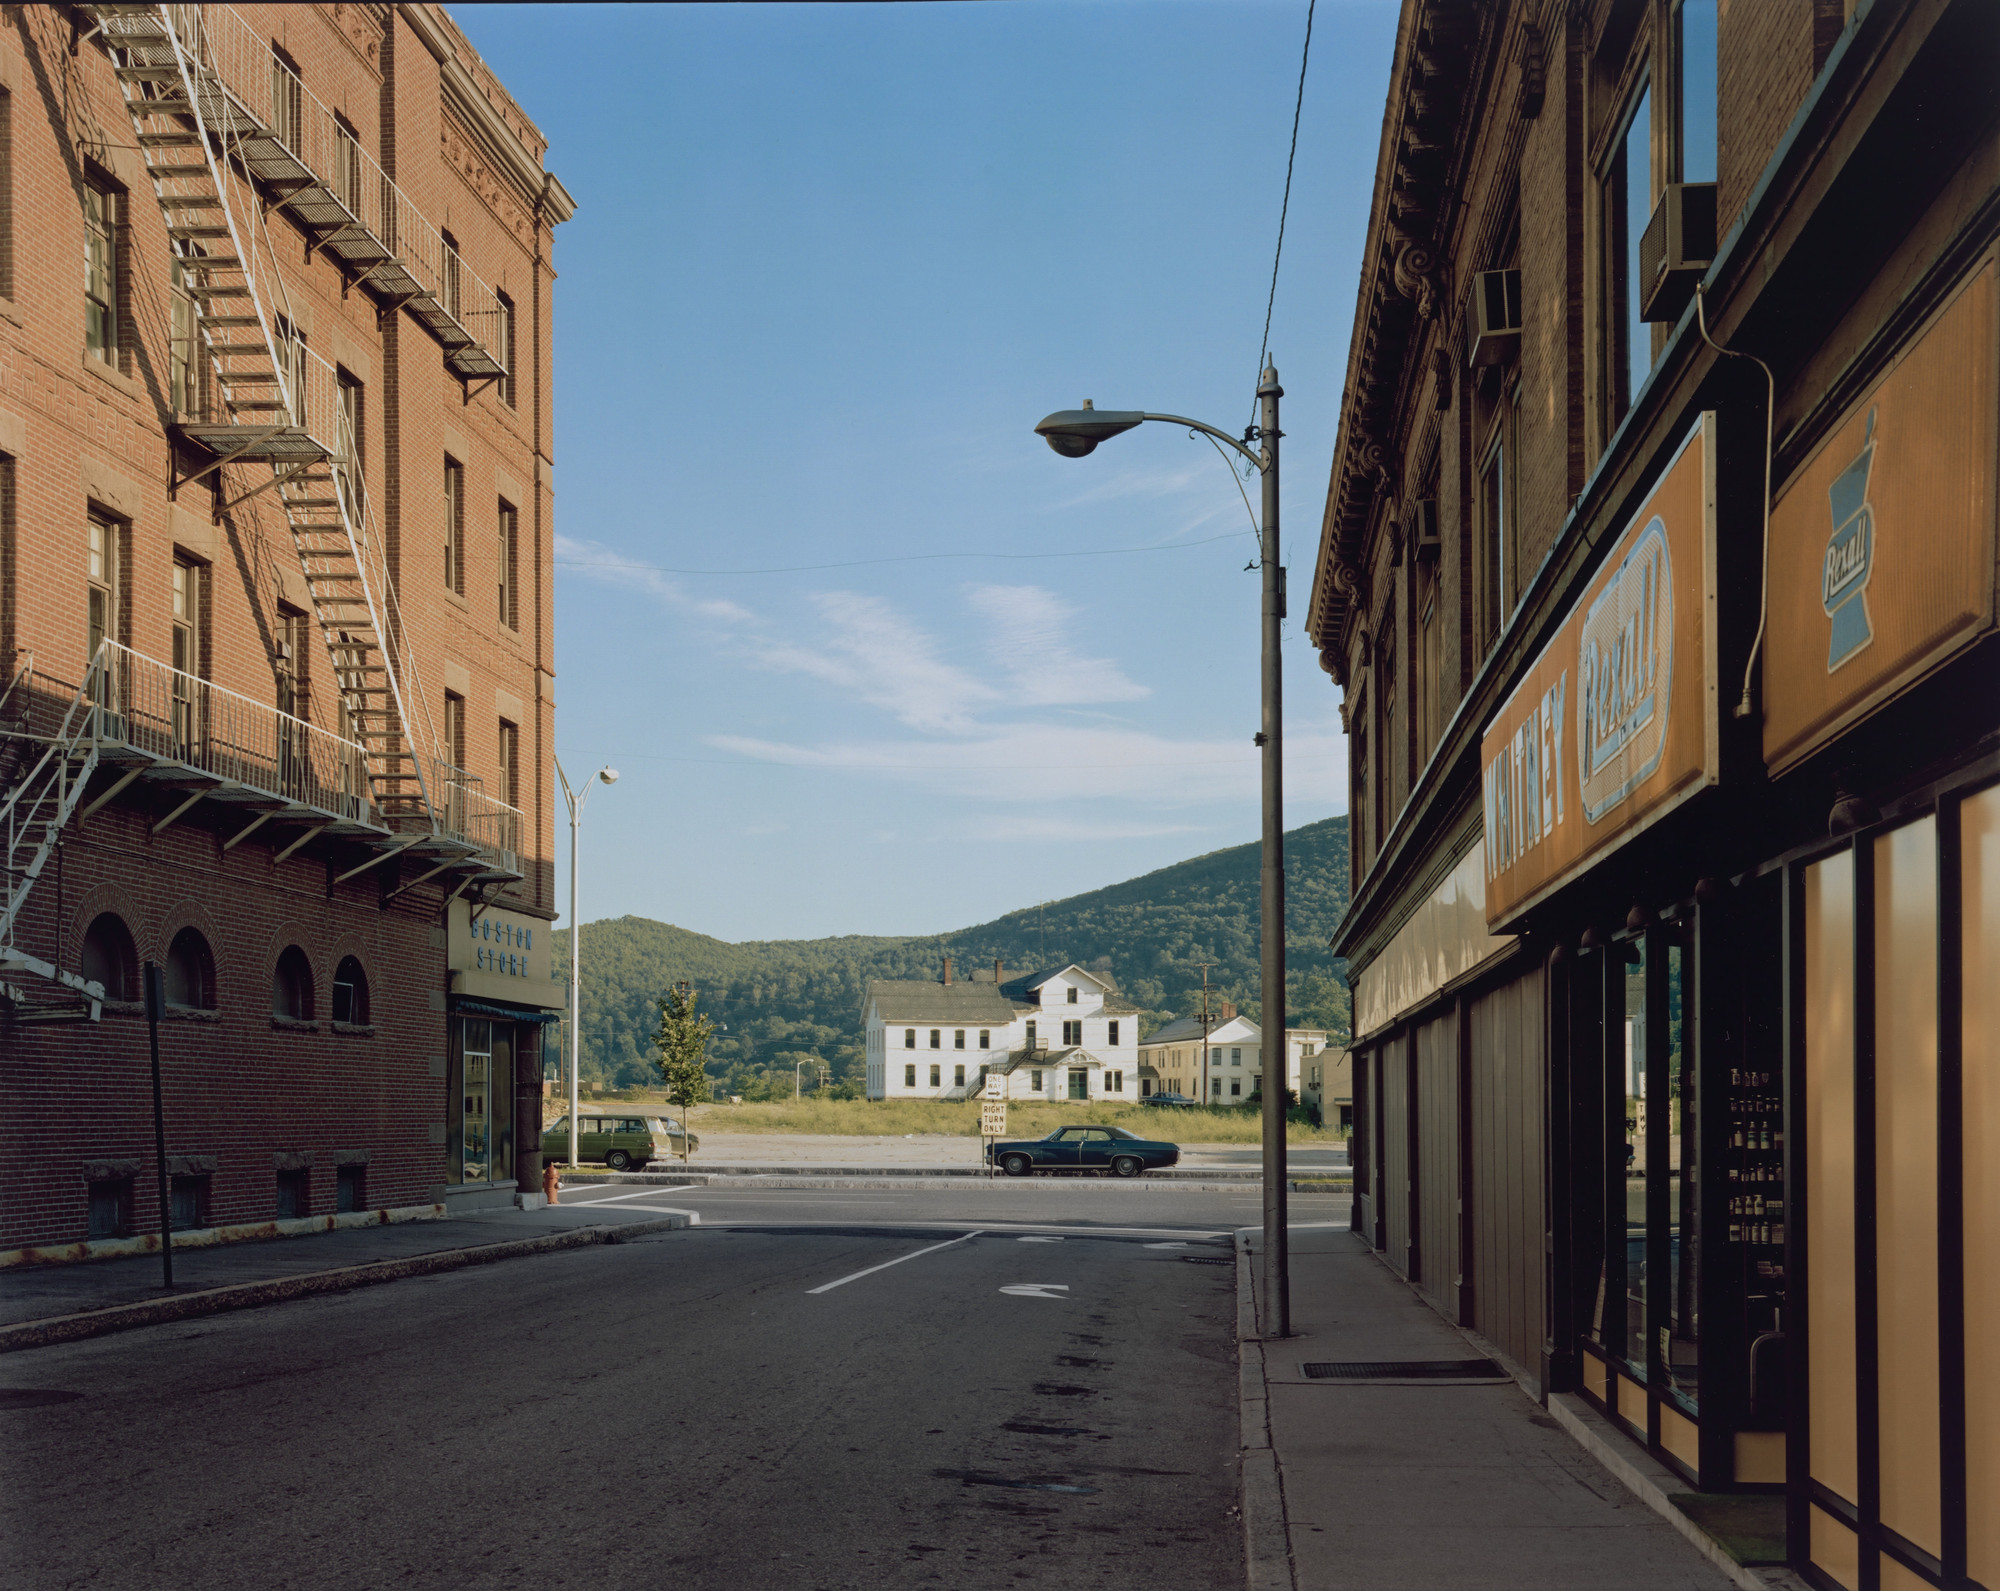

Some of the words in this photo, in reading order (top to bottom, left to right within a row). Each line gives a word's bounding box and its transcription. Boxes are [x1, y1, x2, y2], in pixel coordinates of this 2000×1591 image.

[1824, 515, 1867, 605] Rexall
[1484, 669, 1567, 884] WHITNEY
[1583, 549, 1658, 786] Rexall
[471, 918, 532, 950] BOSTON
[477, 946, 528, 977] STORE
[983, 1105, 1005, 1113] RIGHT
[984, 1115, 1004, 1123] TURN
[984, 1124, 1004, 1132] ONLY
